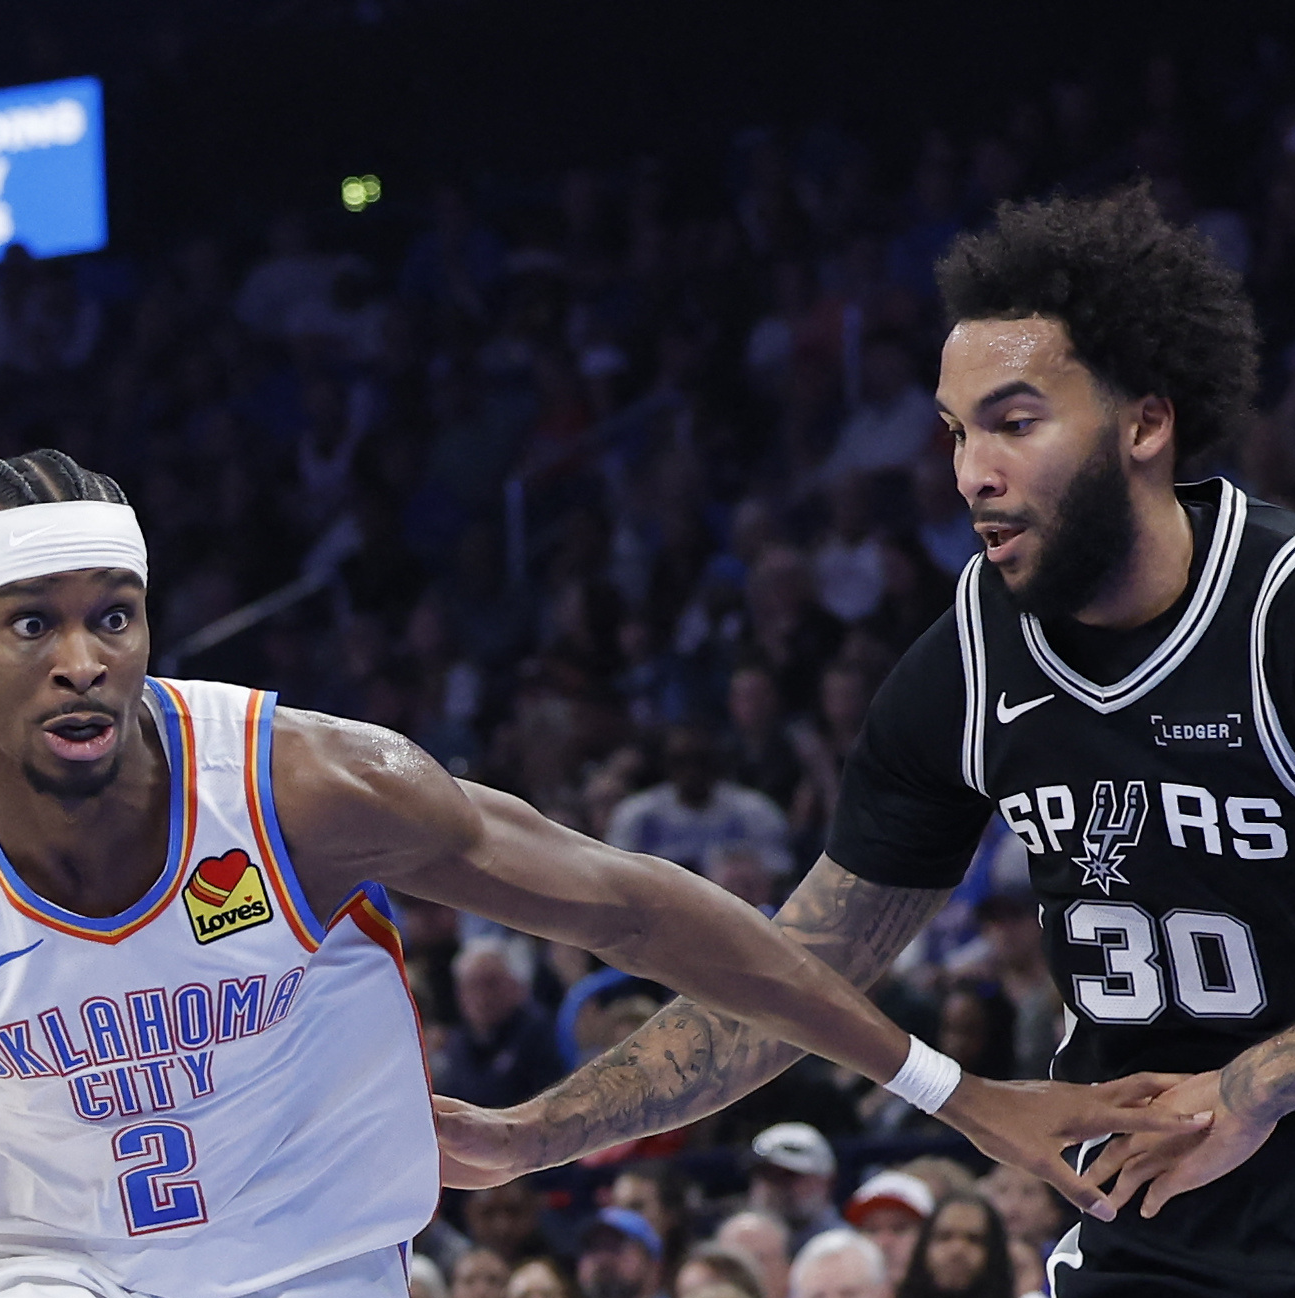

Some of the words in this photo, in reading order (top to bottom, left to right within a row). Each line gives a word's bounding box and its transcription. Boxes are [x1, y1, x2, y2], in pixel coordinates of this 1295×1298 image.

[1162, 724, 1230, 739] LEDGER
[999, 781, 1288, 895] SPURS
[1064, 899, 1268, 1025] 30
[68, 1050, 214, 1120] CITY
[111, 1120, 208, 1237] 2
